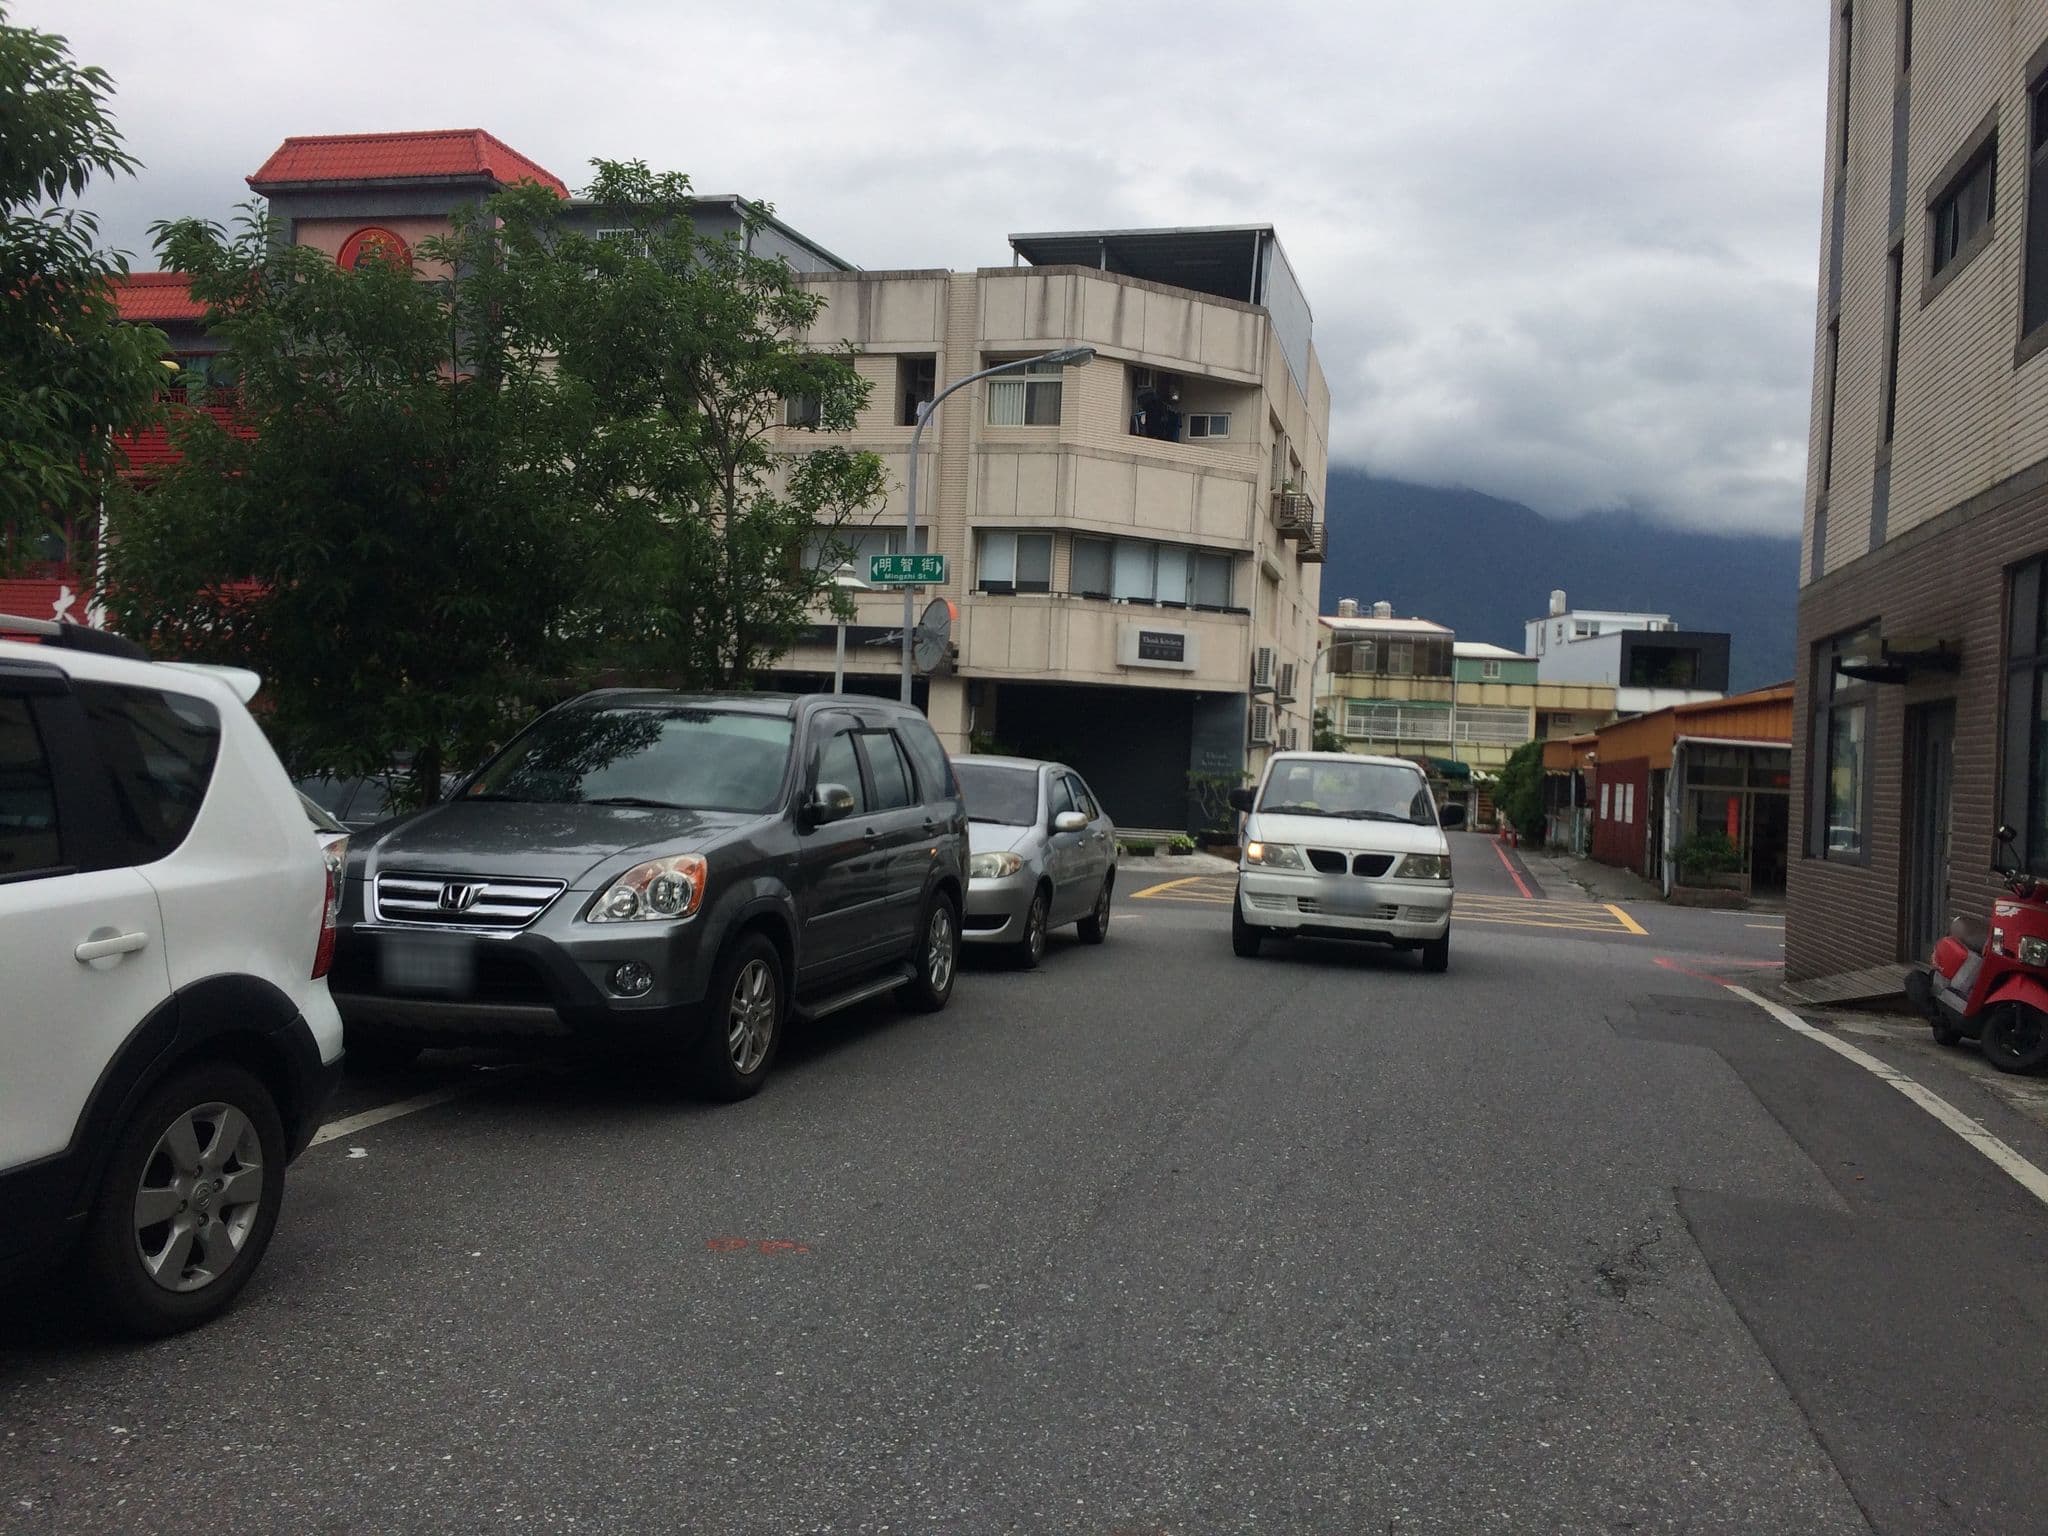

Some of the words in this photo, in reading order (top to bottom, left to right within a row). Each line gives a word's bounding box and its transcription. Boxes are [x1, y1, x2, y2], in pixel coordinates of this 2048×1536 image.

[879, 557, 935, 572] 明智街
[884, 573, 915, 581] Mingzhi
